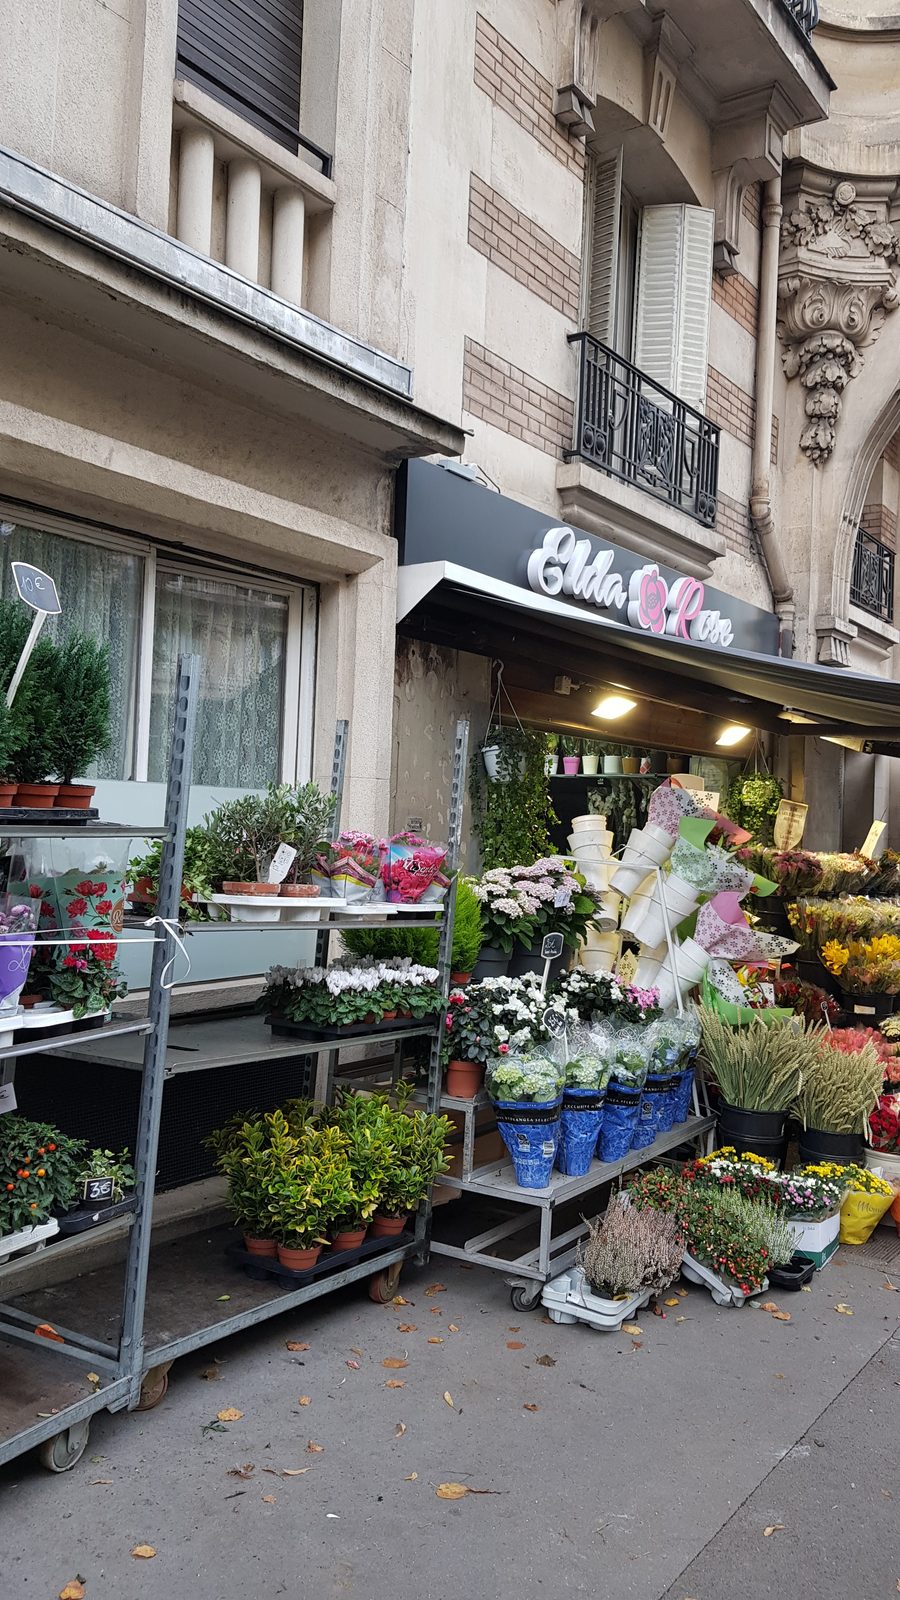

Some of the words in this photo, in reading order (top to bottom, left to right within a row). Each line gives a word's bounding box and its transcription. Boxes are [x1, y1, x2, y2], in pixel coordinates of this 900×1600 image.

[527, 526, 627, 609] Elda
[667, 576, 734, 647] Rose
[89, 1181, 112, 1199] 3€
